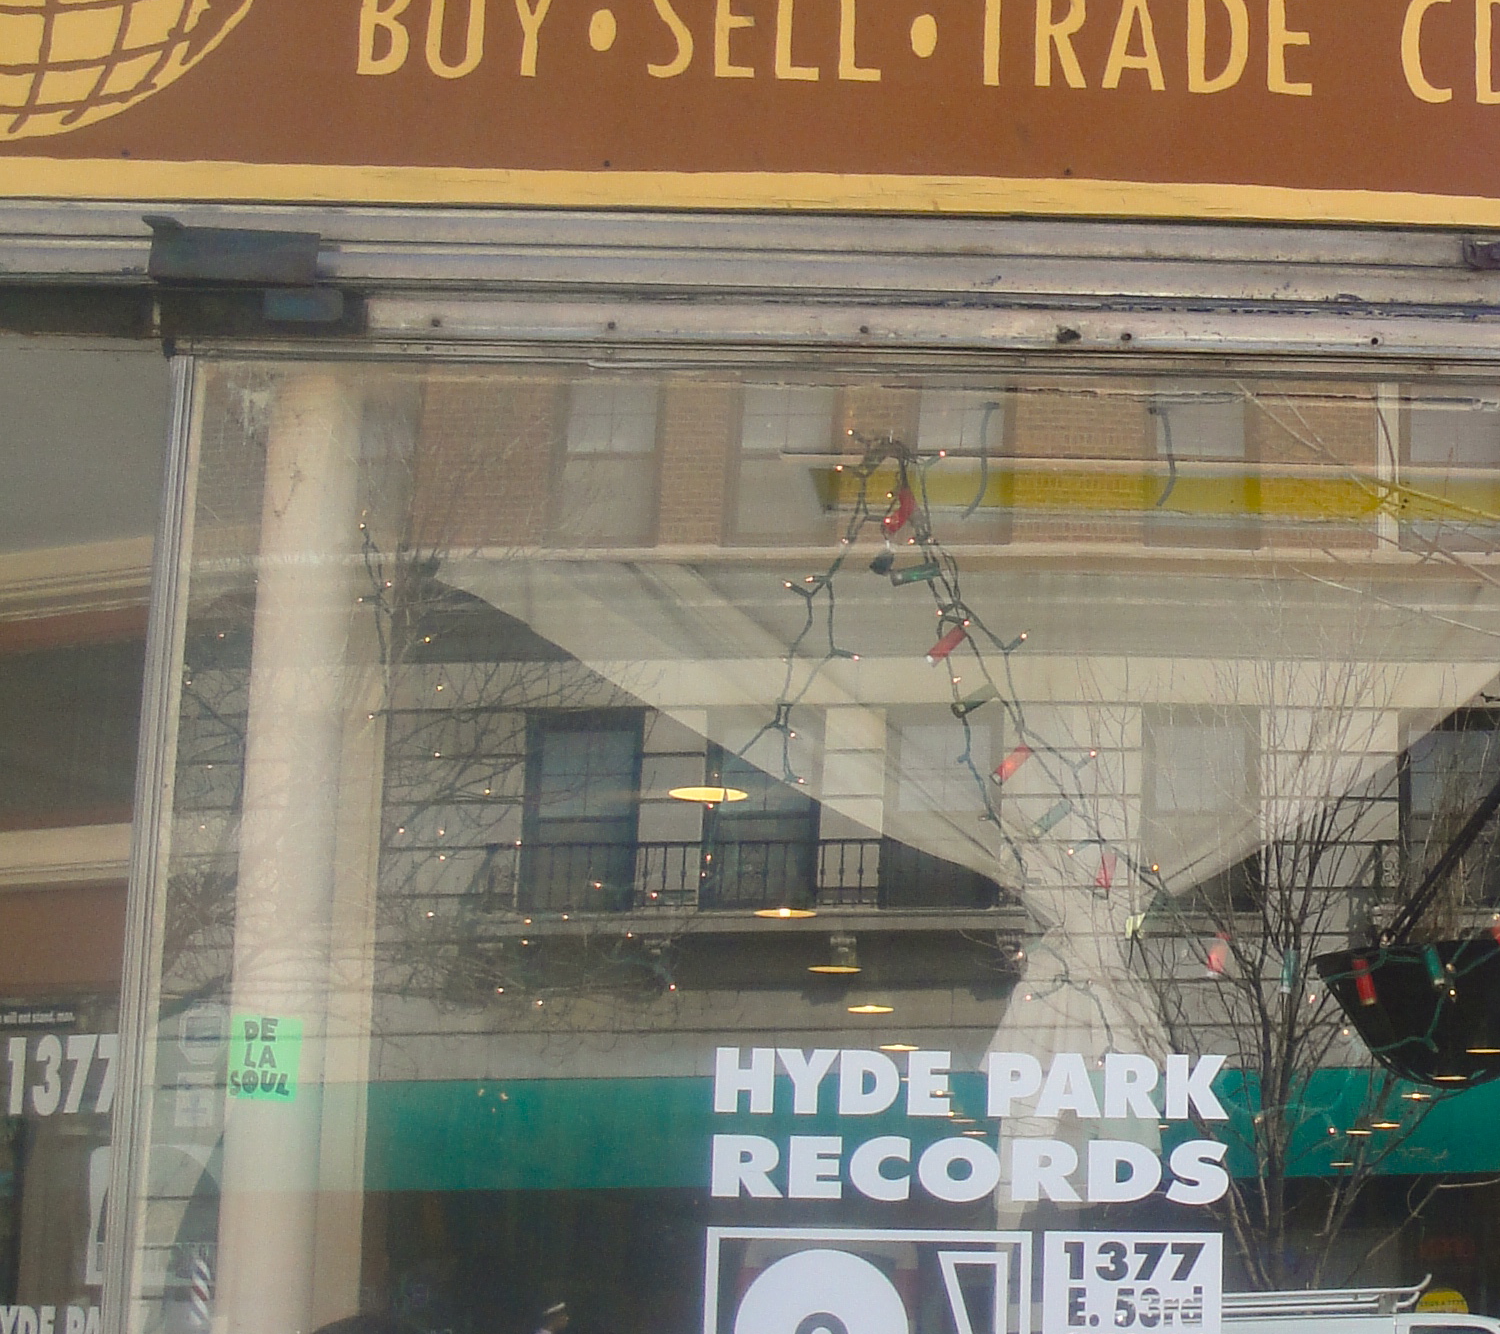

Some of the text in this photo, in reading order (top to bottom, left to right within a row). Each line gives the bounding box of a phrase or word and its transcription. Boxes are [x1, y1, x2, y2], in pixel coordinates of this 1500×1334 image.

[244, 1018, 279, 1042] DE
[8, 1033, 120, 1116] 1377
[244, 1043, 277, 1068] LA
[230, 1069, 290, 1097] SOUL
[712, 1046, 1230, 1120] HYDE PARK
[709, 1133, 1231, 1205] RECORDS
[1064, 1240, 1207, 1282] 1377
[1067, 1285, 1204, 1329] E. 53rd
